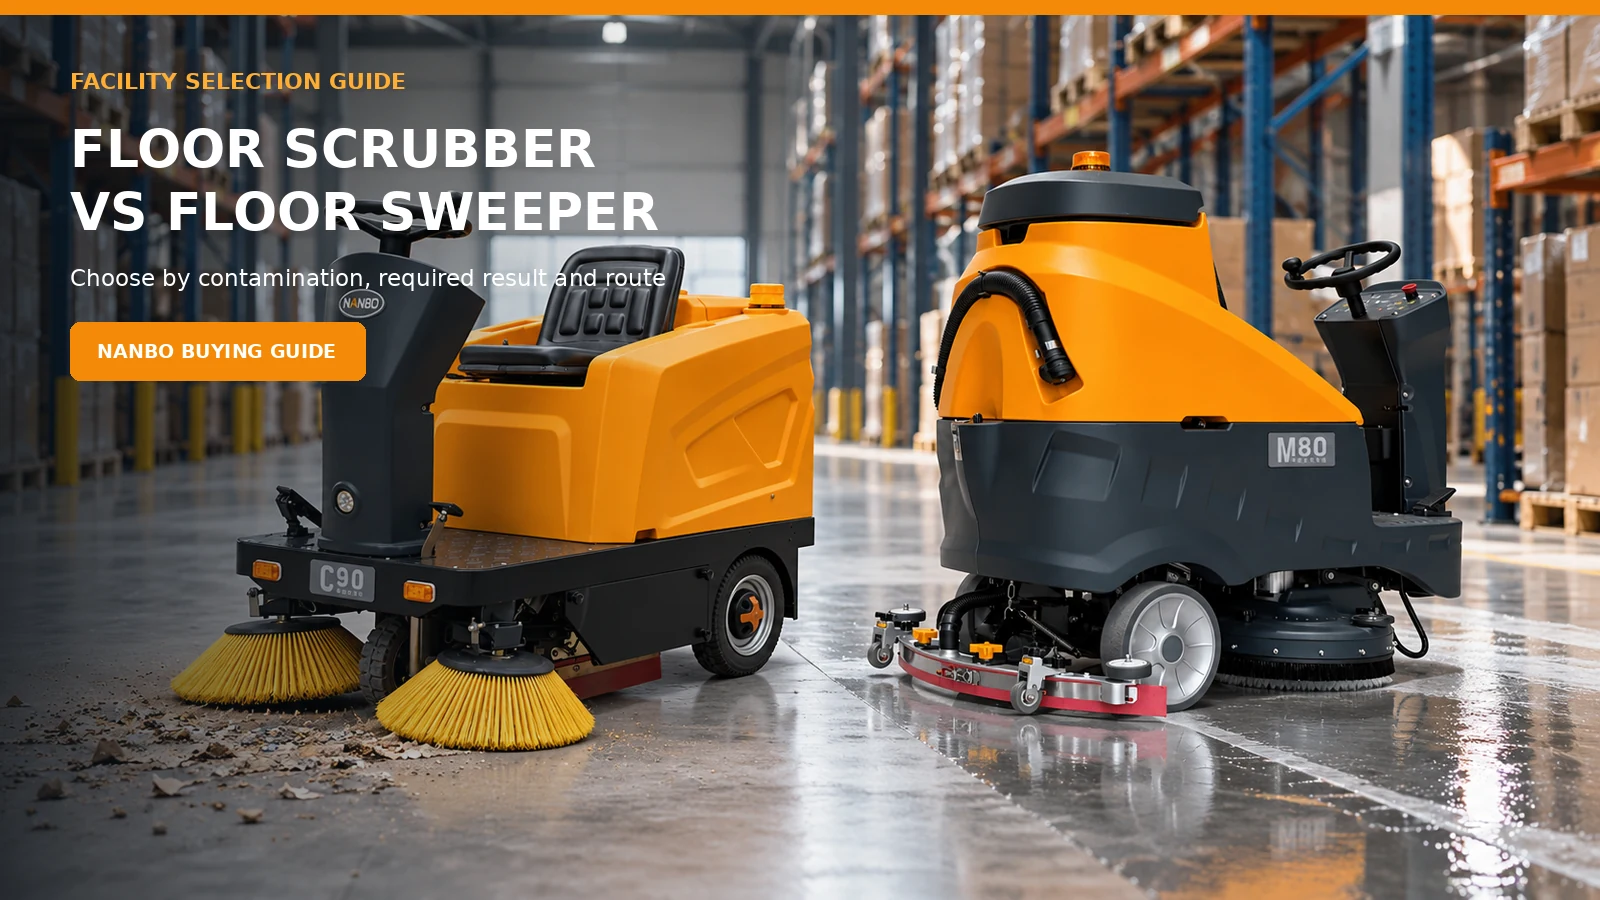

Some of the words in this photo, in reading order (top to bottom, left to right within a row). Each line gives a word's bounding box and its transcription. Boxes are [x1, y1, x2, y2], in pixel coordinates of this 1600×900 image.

[343, 297, 379, 309] NANBO
[1277, 436, 1327, 463] M80
[320, 564, 364, 593] C90
